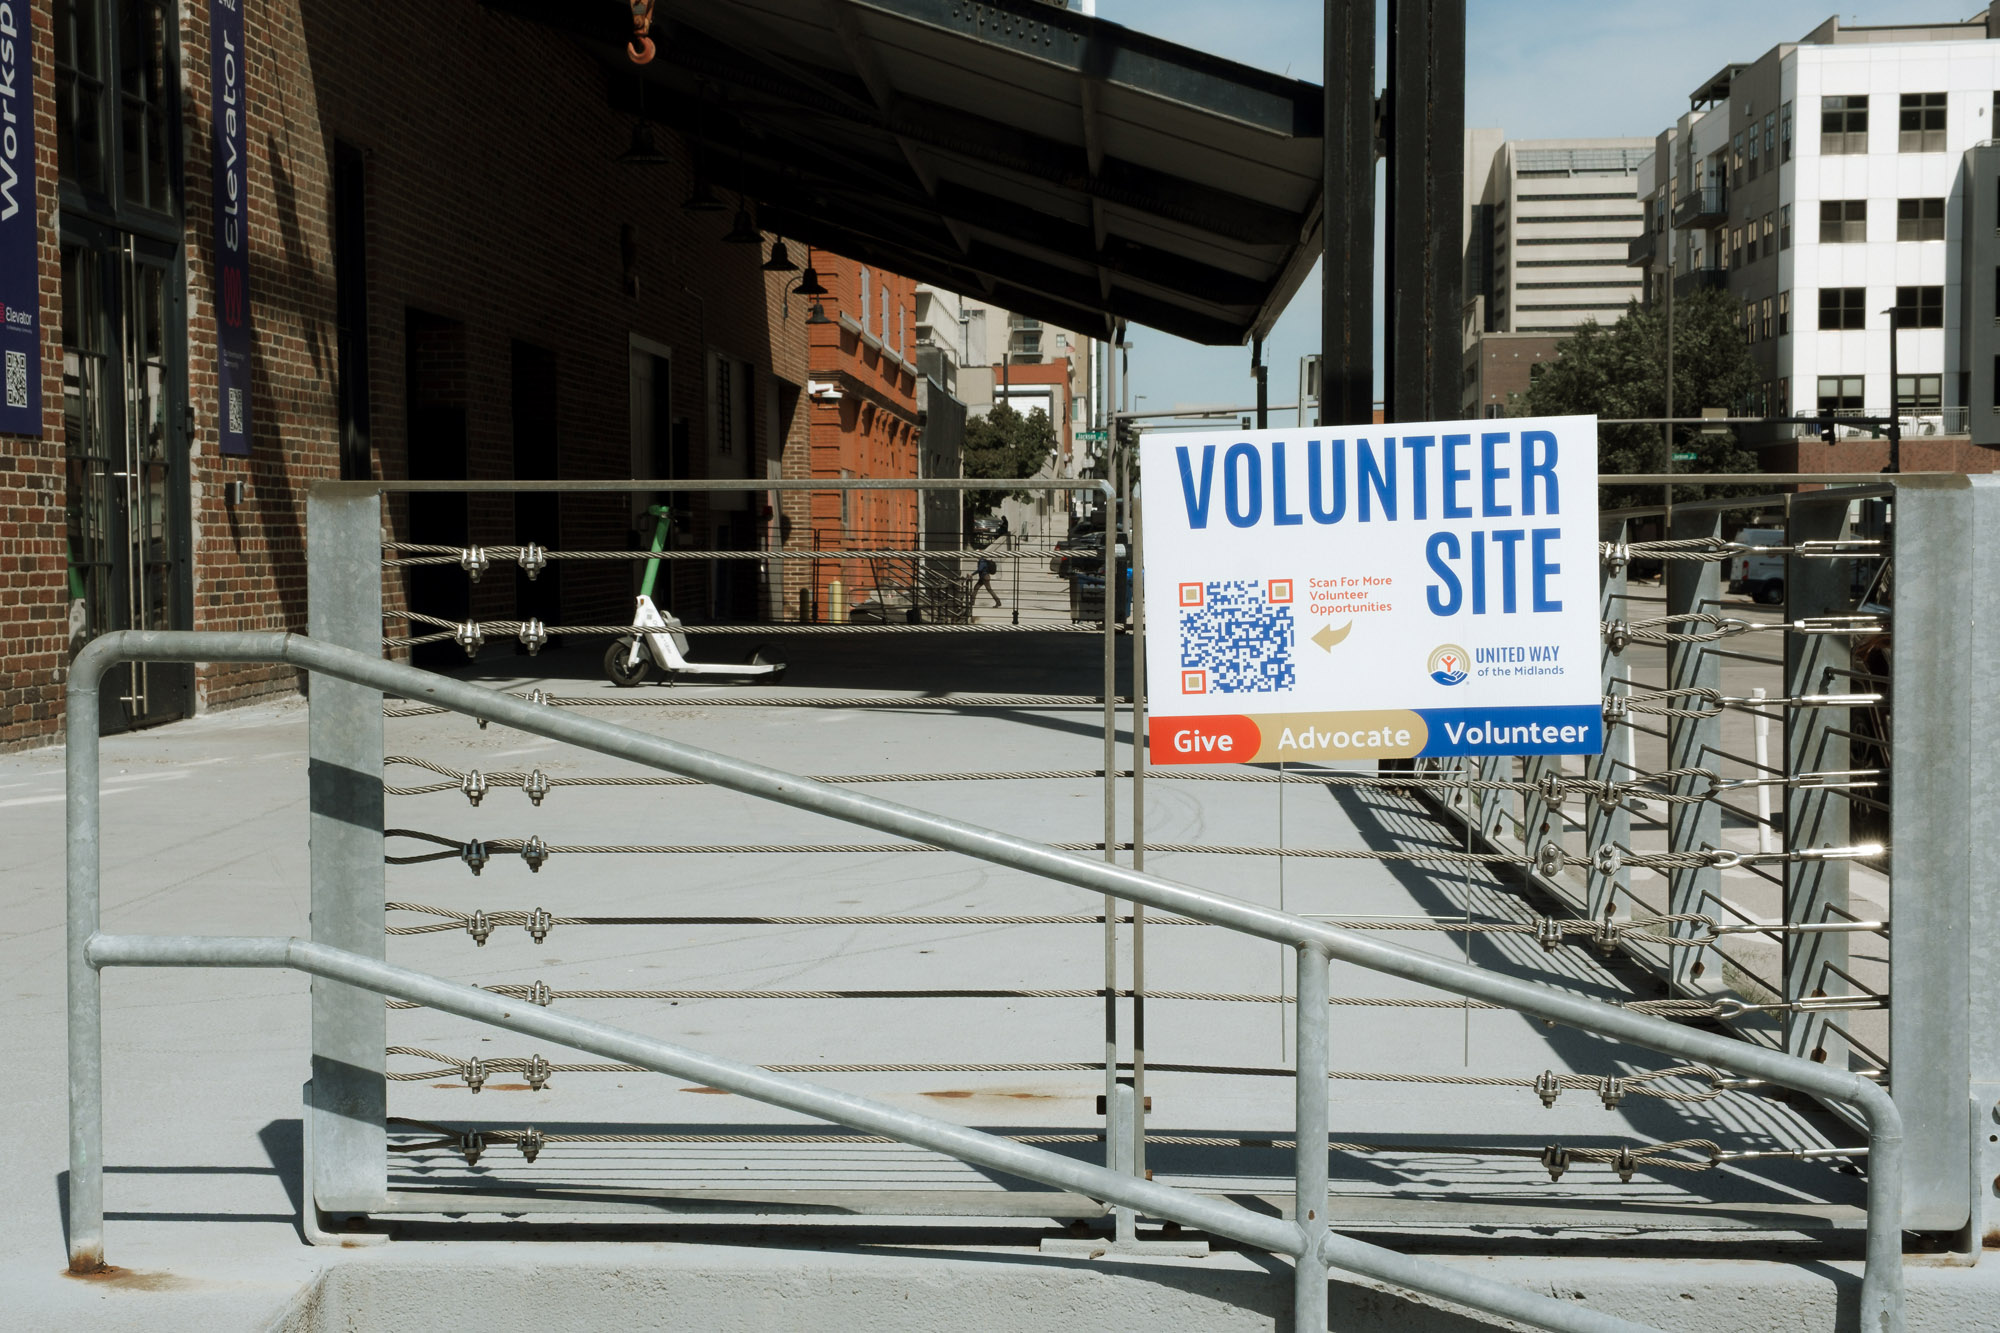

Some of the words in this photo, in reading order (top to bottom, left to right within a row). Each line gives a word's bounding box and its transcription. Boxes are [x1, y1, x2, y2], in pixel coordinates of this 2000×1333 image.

[0, 0, 18, 221] Worksp
[223, 29, 239, 252] Elevator
[5, 306, 32, 325] Elevator
[1175, 430, 1560, 530] VOLUNTEER
[1309, 577, 1337, 588] Scan
[1340, 576, 1360, 587] For
[1362, 576, 1393, 586] More
[1425, 528, 1563, 617] SITE
[1309, 590, 1369, 601] Volunteer
[1310, 601, 1392, 616] Opportunities
[1475, 646, 1525, 664] UNITED
[1528, 645, 1560, 662] WAY
[1477, 667, 1489, 677] of
[1492, 666, 1511, 676] the
[1514, 665, 1565, 676] Midlands
[1173, 729, 1234, 753] Give
[1277, 725, 1411, 750] Advocate
[1444, 720, 1589, 745] Volunteer
